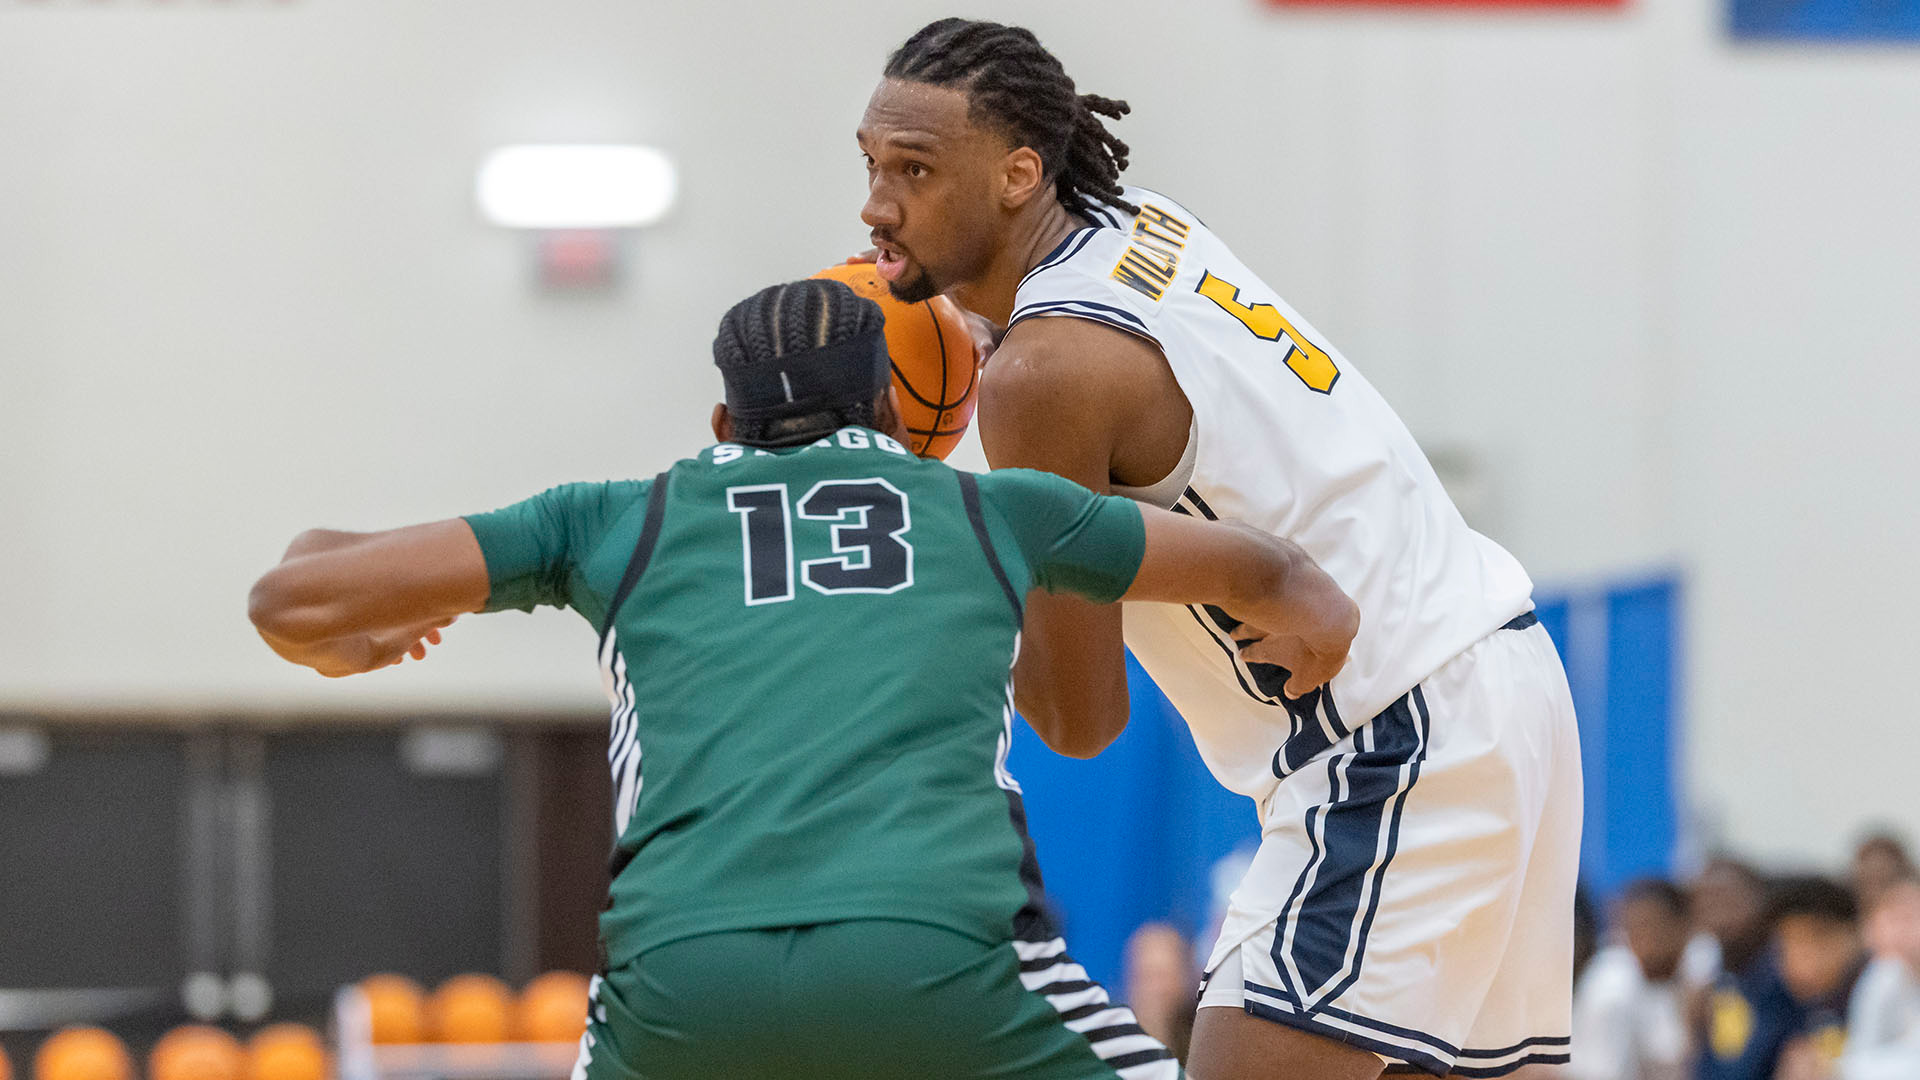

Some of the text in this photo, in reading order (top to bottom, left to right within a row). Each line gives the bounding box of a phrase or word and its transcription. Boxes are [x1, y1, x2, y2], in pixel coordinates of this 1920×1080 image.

[1195, 268, 1341, 395] 5
[712, 428, 907, 465] SGG
[726, 477, 914, 606] 13
